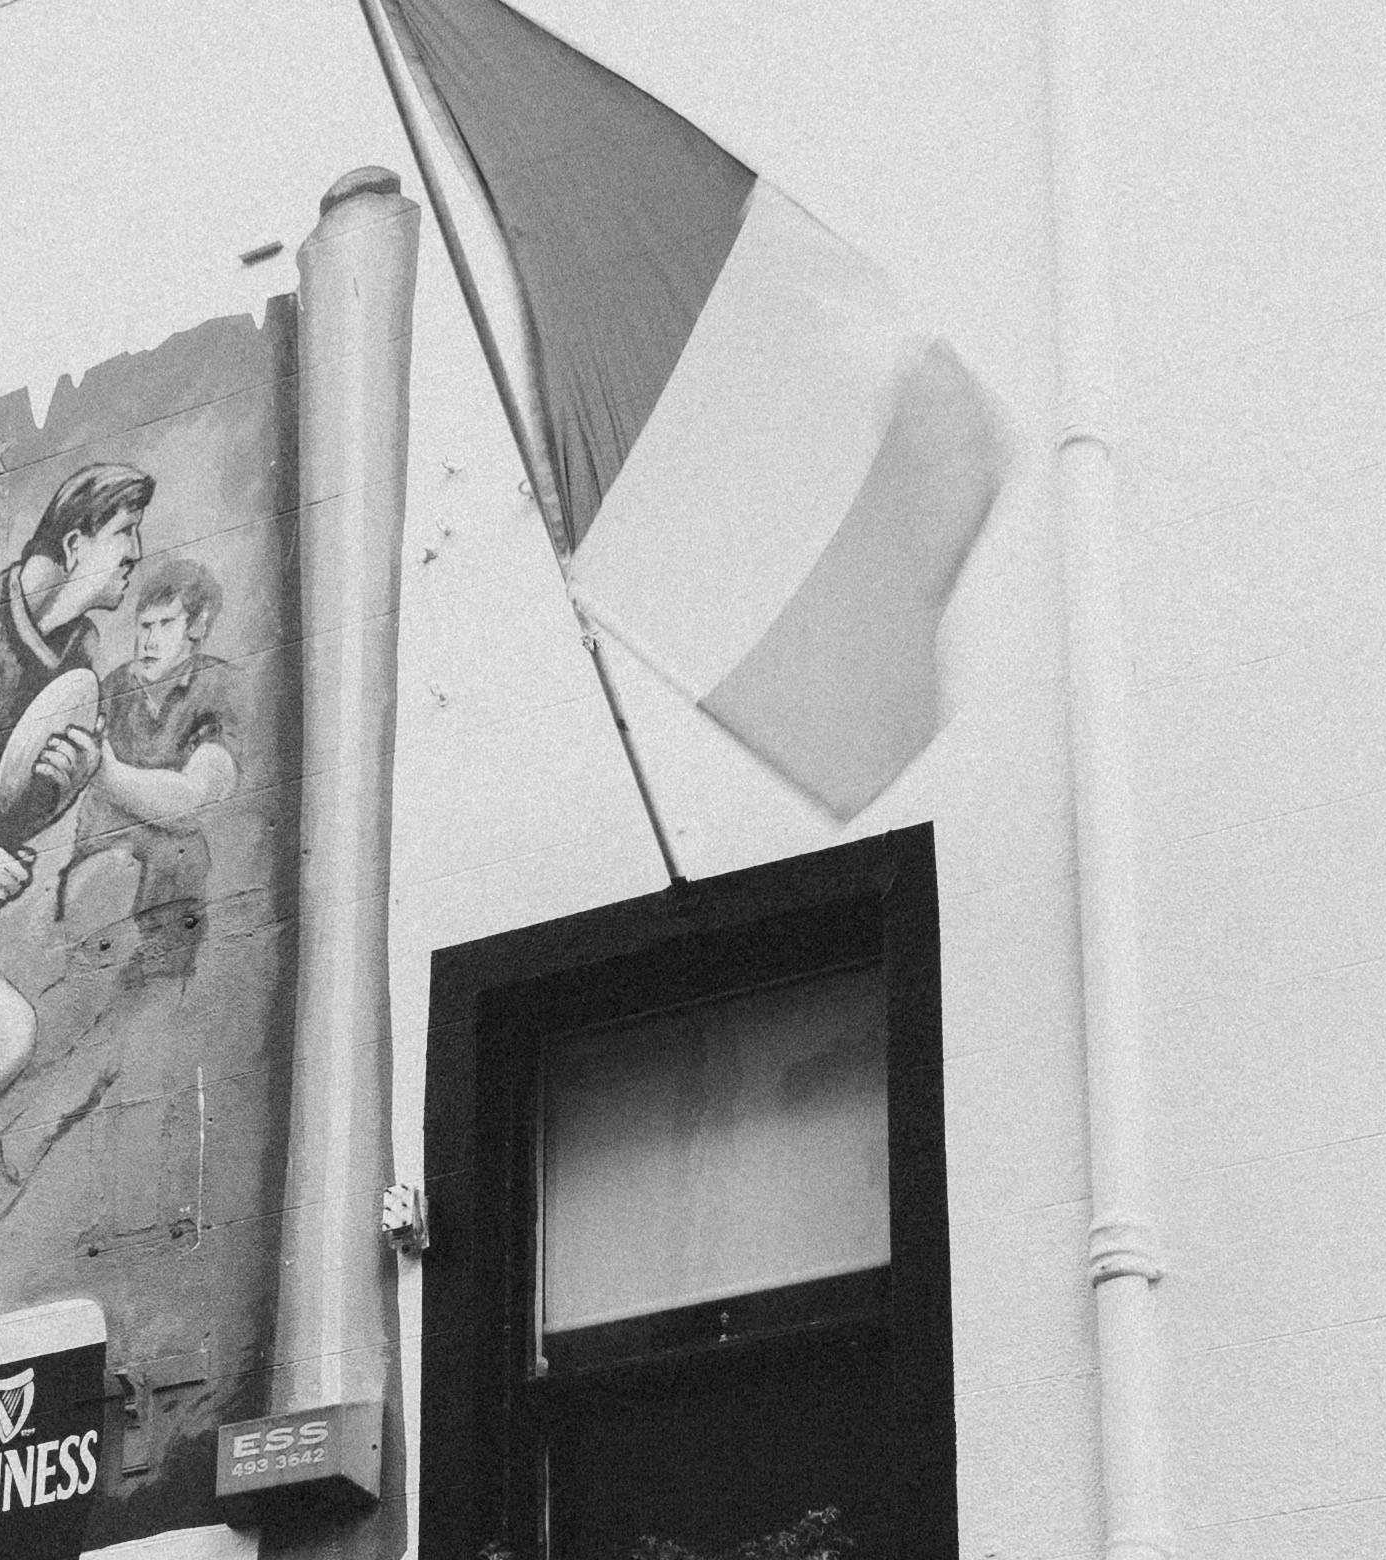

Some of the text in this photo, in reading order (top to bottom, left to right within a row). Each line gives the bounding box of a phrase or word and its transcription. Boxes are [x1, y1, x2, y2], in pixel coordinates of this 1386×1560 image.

[232, 1420, 329, 1458] ESS
[231, 1447, 326, 1477] 493 3642
